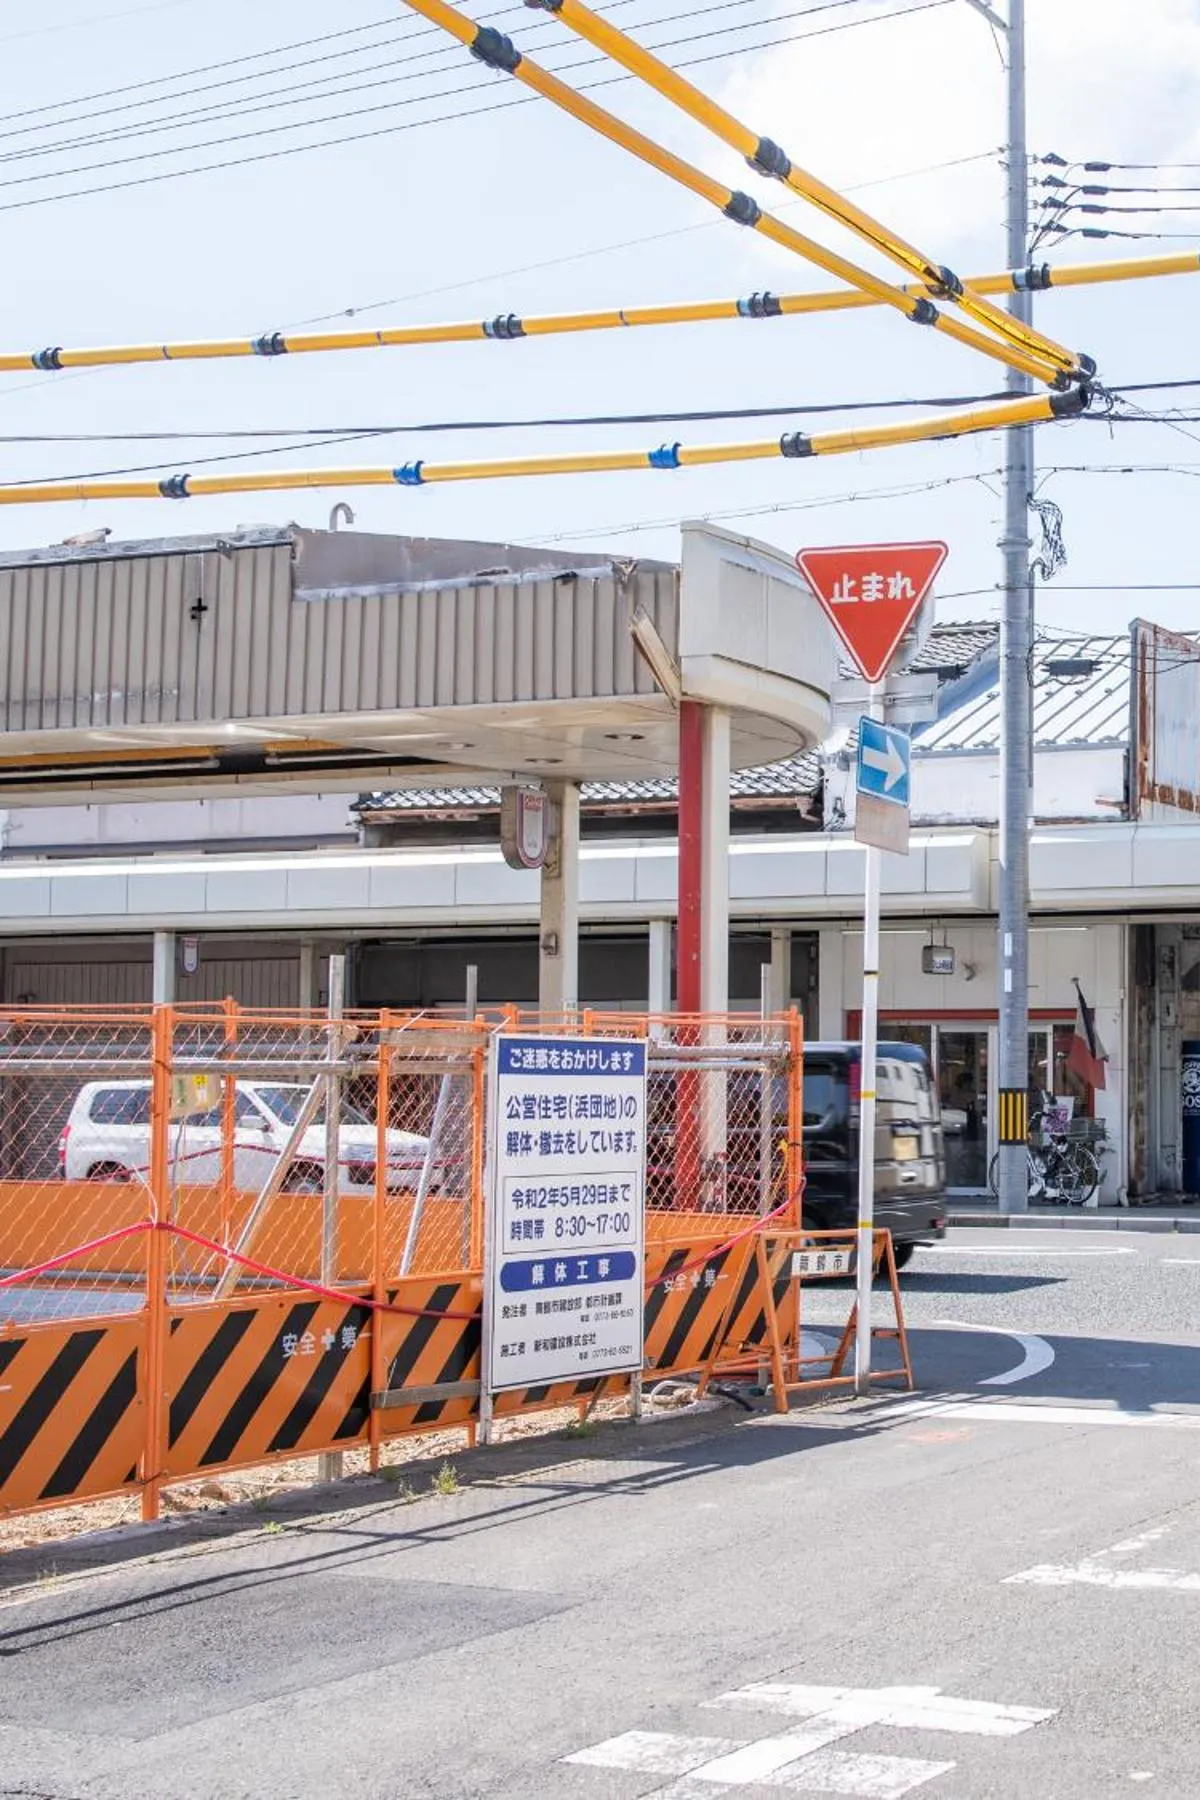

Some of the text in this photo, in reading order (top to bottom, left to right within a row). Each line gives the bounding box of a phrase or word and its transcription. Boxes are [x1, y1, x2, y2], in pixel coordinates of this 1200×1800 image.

[830, 571, 917, 604] 止まれ
[510, 1047, 634, 1072] ご迷惑をおかけします
[506, 1093, 637, 1120] 公営住宅(浜団地)の
[511, 1183, 631, 1209] 令和2年5月29日まで
[510, 1218, 545, 1241] 時間帯
[282, 1325, 372, 1358] 安全 第一
